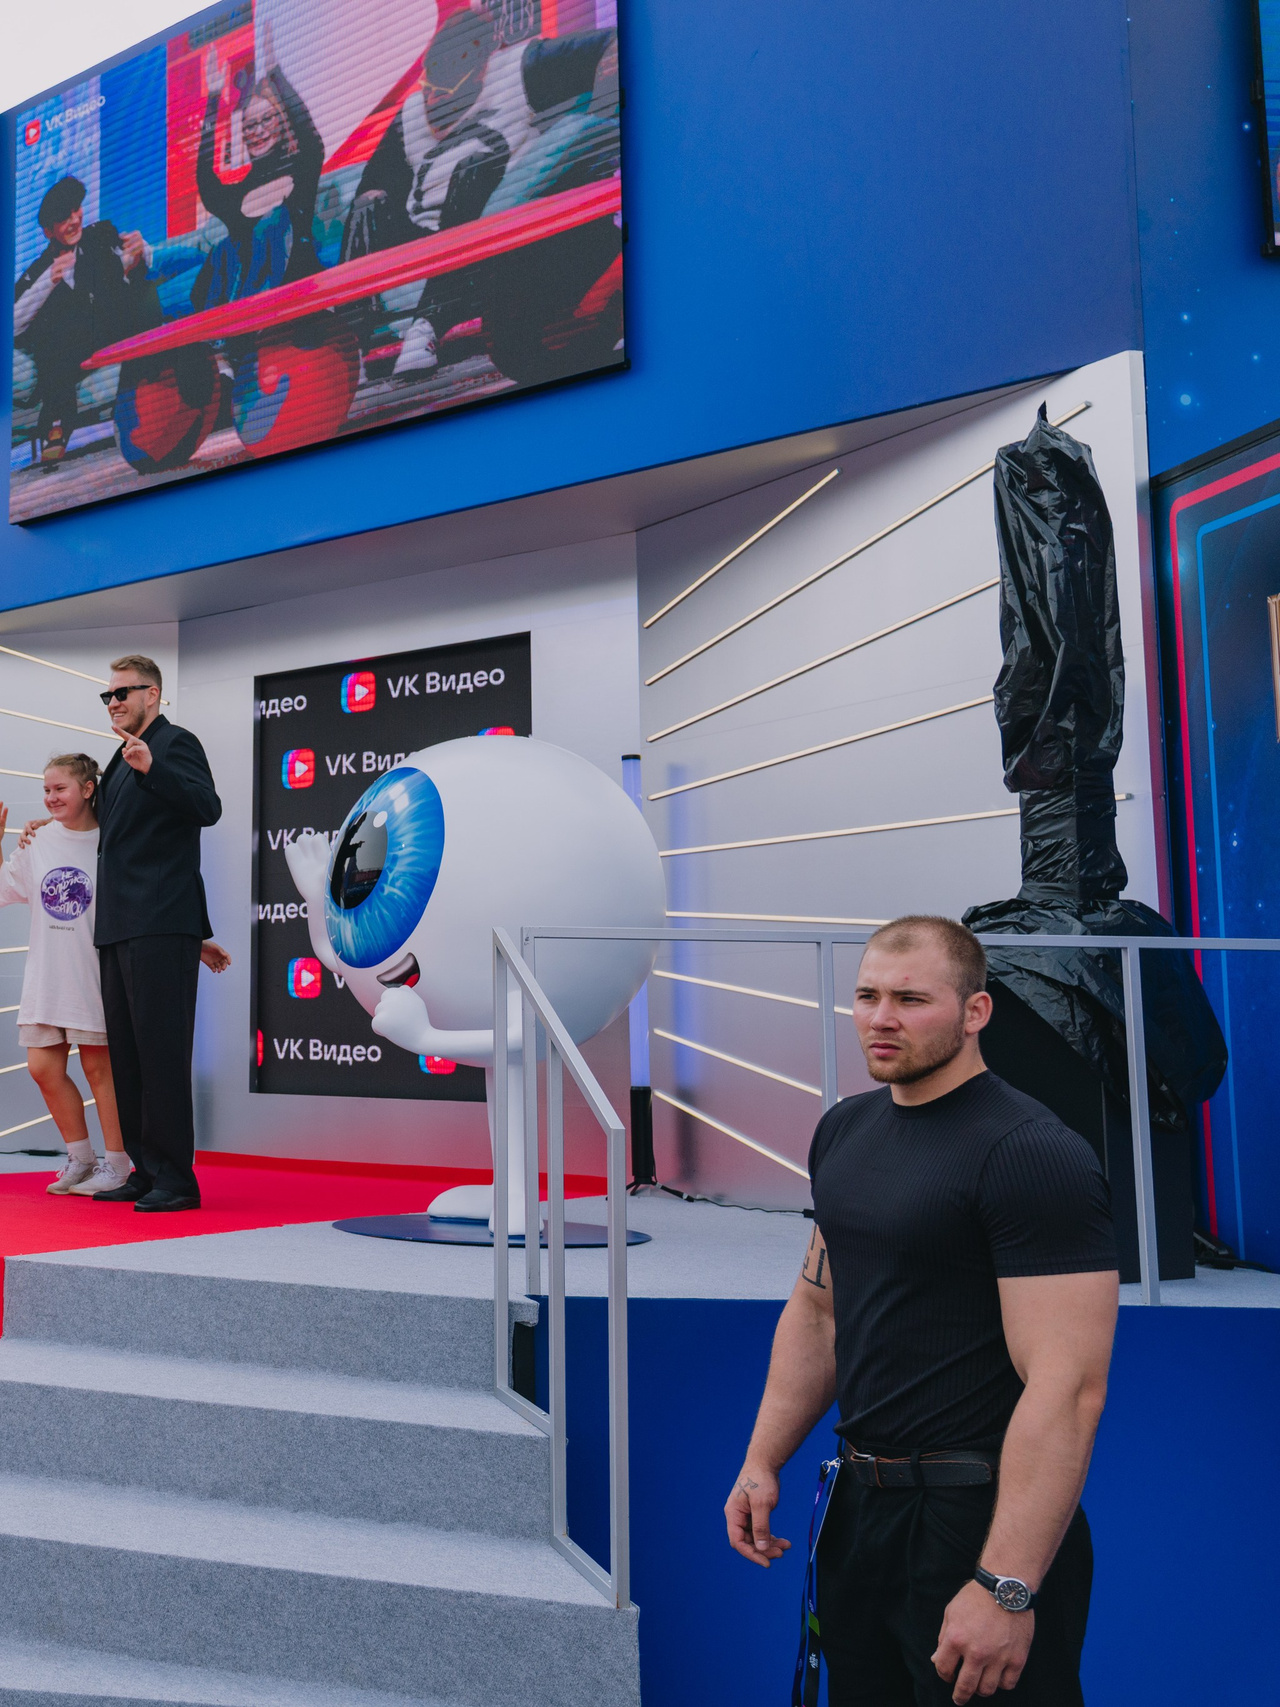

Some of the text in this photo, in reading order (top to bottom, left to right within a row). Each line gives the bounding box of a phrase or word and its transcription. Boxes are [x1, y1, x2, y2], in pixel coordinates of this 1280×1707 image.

[45, 95, 106, 132] VK Видео
[387, 668, 505, 698] VK Видео
[325, 752, 357, 776] VK
[273, 1038, 382, 1066] VK Видео
